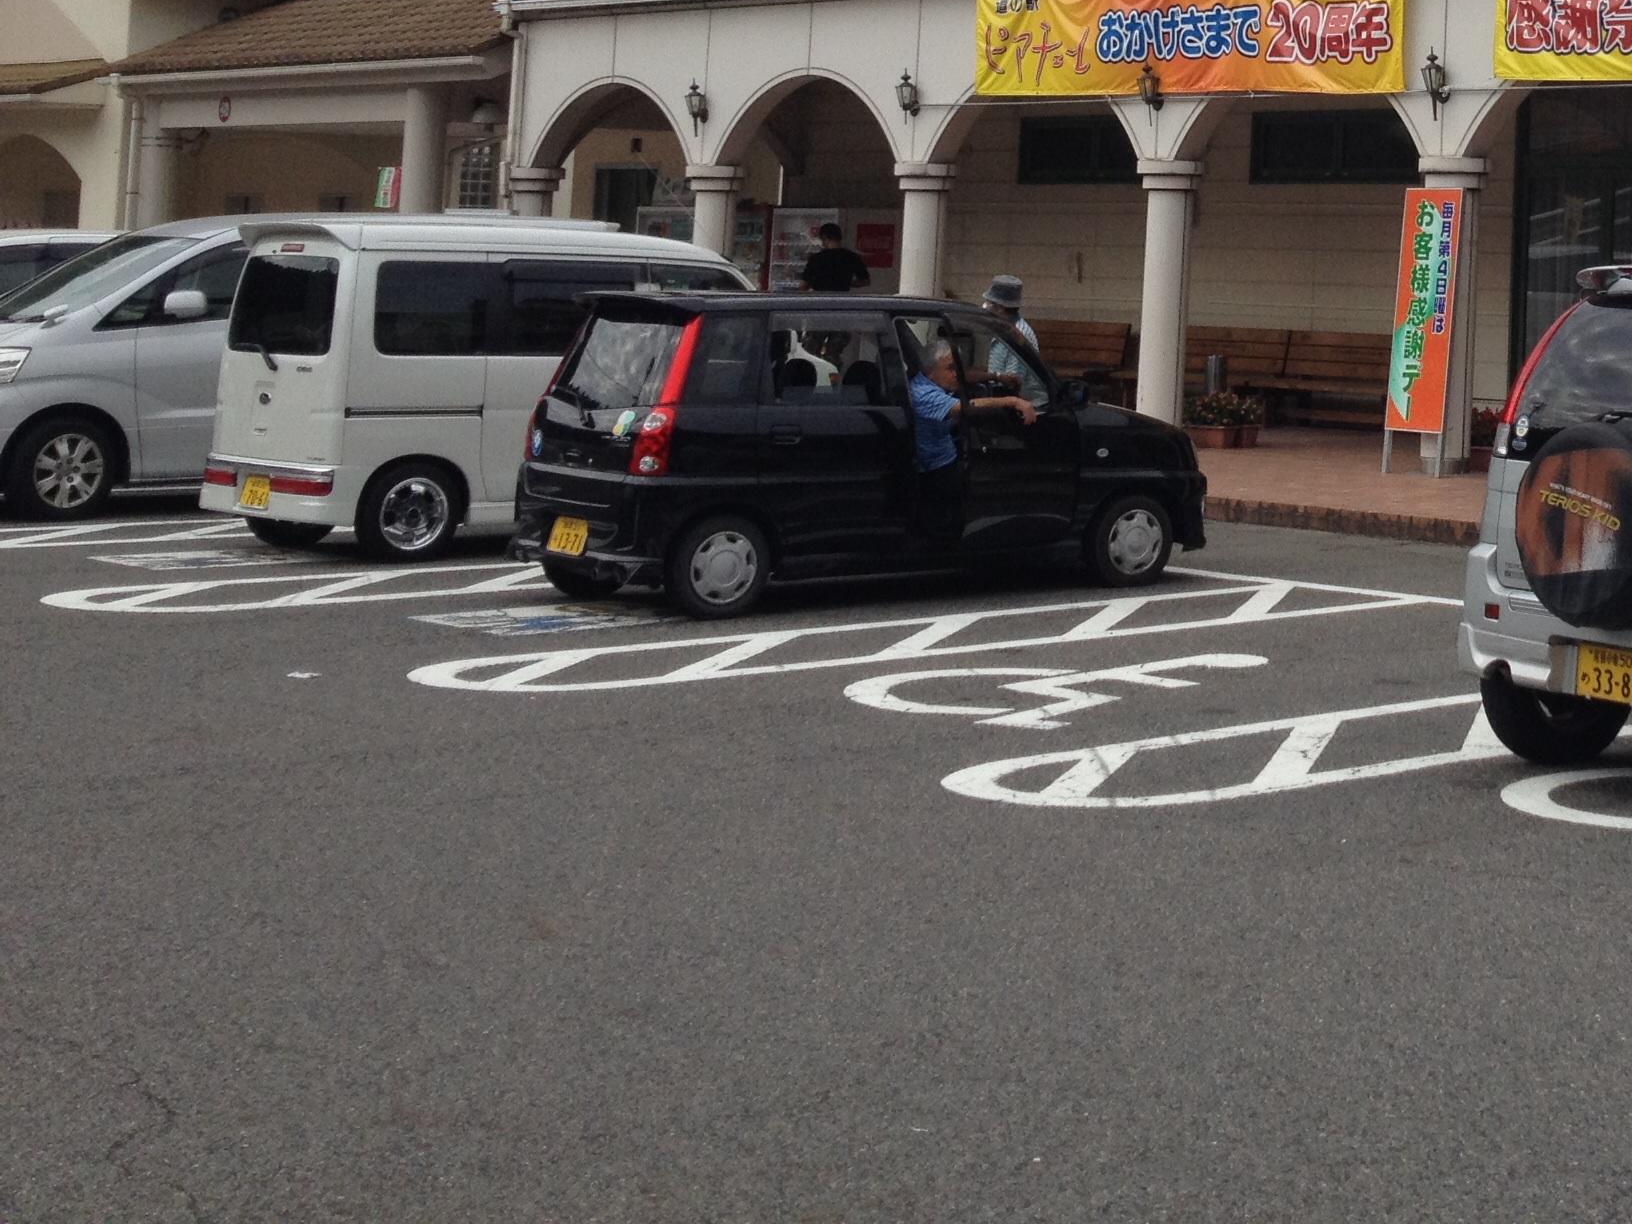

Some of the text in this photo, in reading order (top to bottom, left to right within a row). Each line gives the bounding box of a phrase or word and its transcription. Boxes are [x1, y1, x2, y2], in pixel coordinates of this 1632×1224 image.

[1096, 2, 1261, 64] おかげさまで
[1402, 200, 1436, 422] お客様感謝デー
[1539, 488, 1593, 518] TERIOS
[1592, 508, 1621, 531] KID
